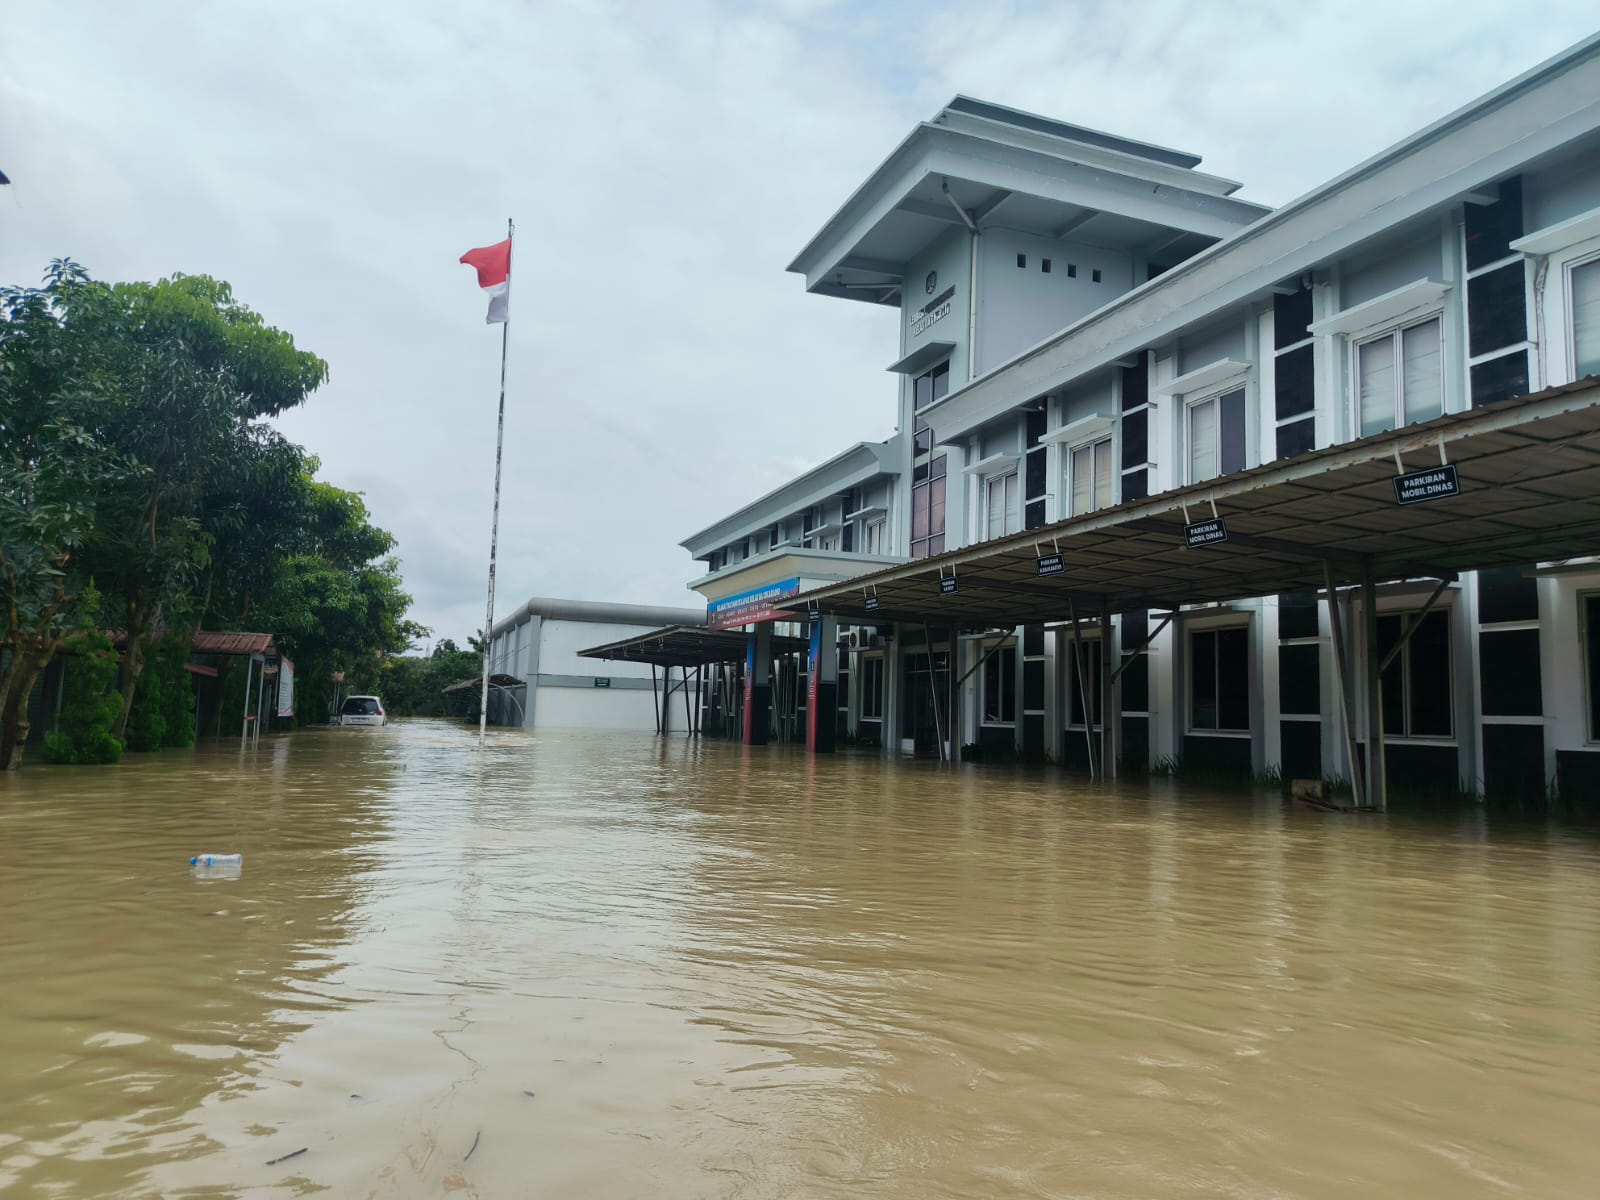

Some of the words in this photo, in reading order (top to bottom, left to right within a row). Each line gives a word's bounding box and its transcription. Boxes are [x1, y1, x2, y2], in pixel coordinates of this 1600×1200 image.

[1403, 472, 1446, 488] PARKIRAN
[1401, 487, 1427, 499] MOBIL
[1427, 481, 1454, 494] DINAS
[1190, 524, 1218, 535] PARKIRAN
[1189, 535, 1205, 543] MOBIL
[1206, 531, 1224, 540] DINAS
